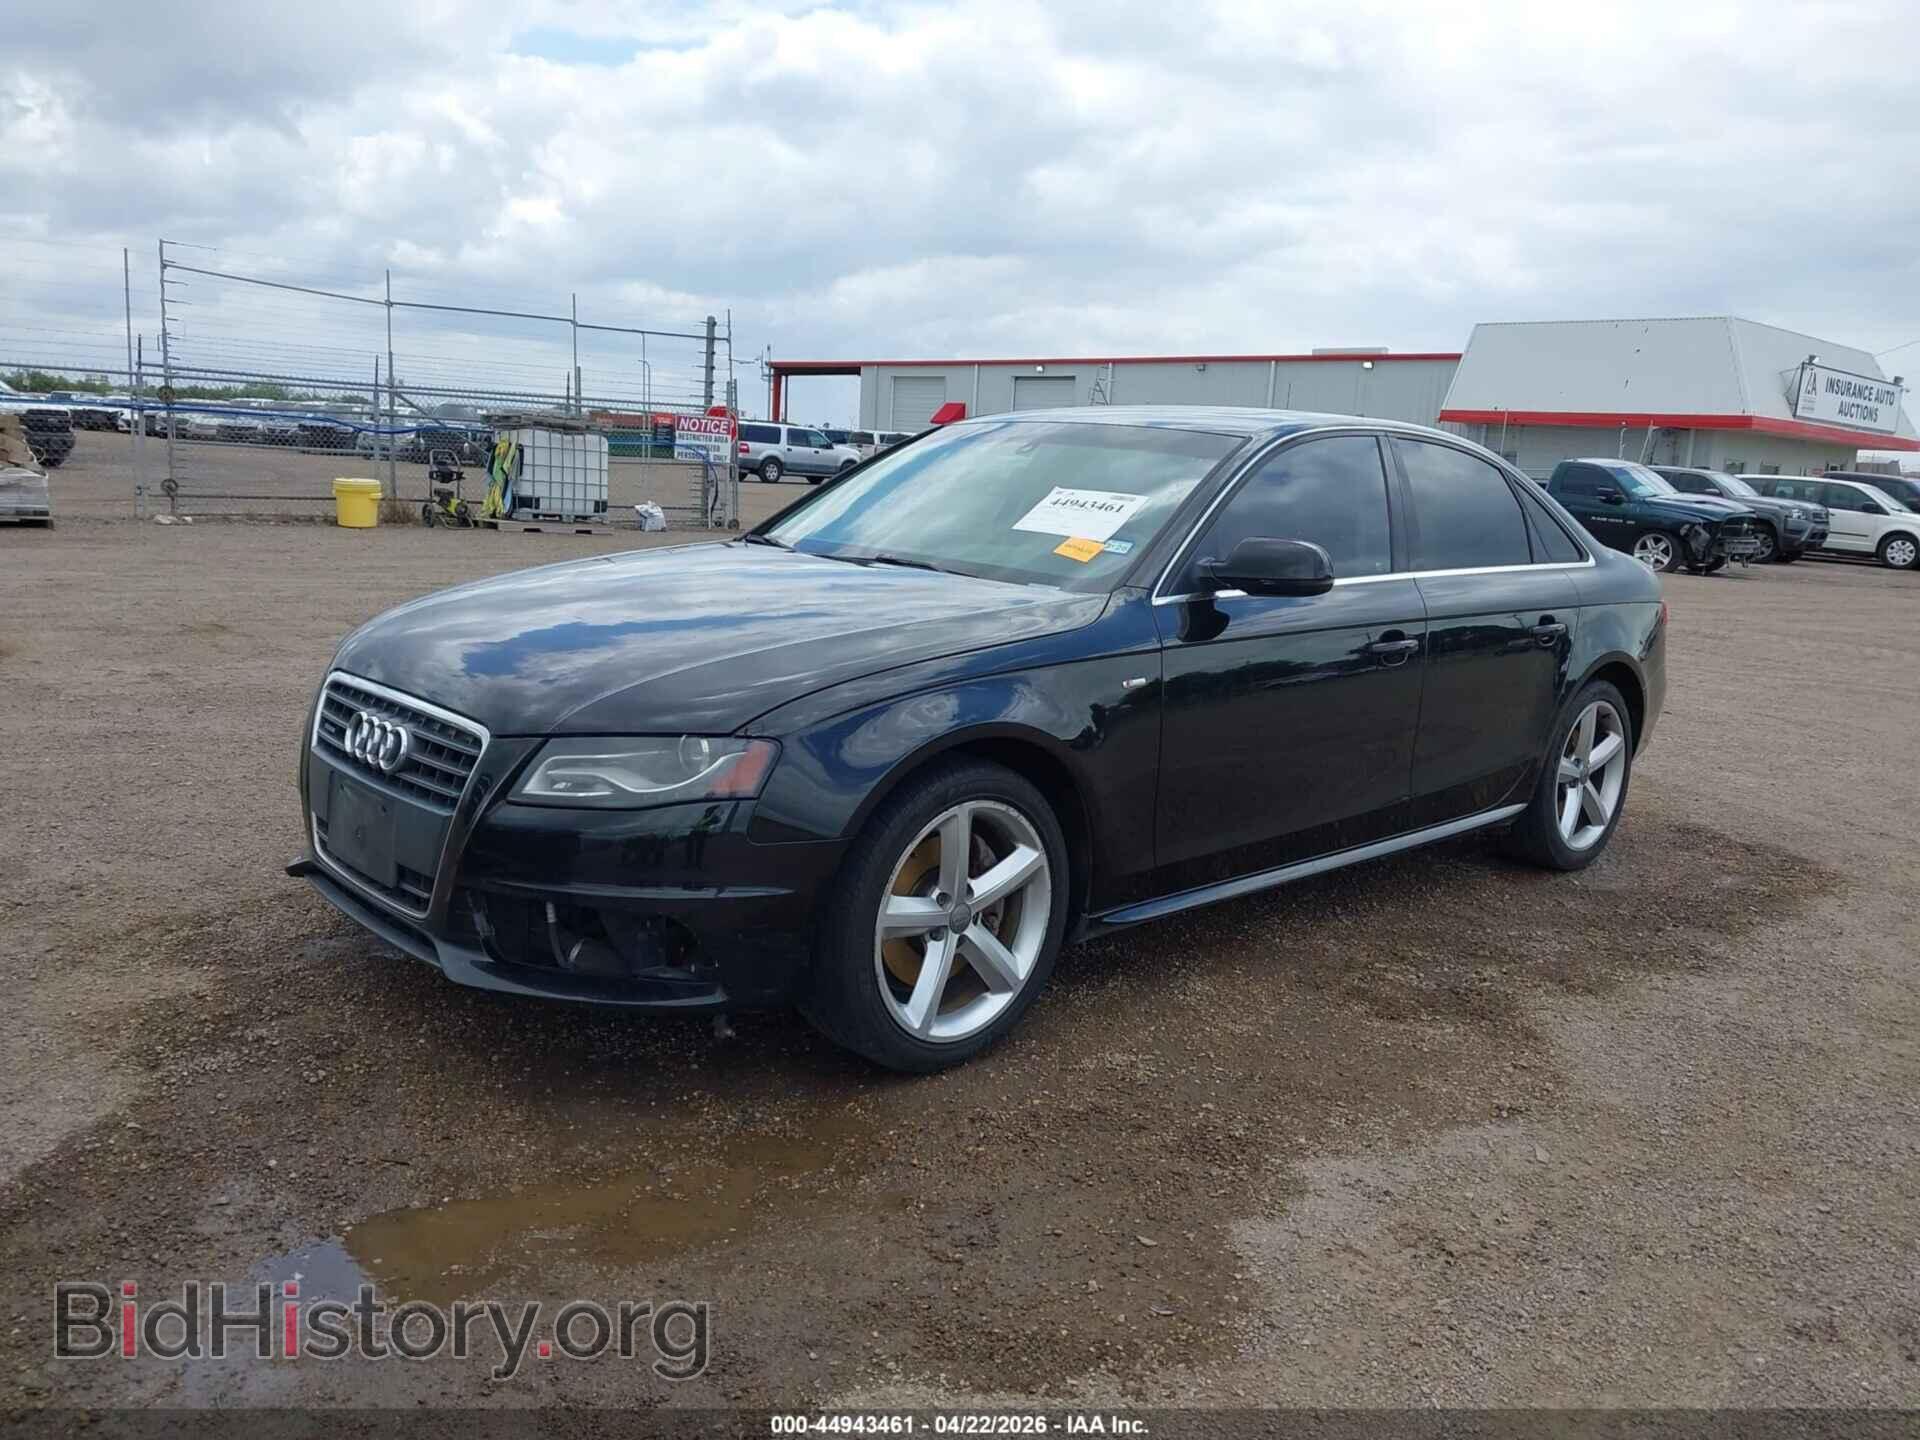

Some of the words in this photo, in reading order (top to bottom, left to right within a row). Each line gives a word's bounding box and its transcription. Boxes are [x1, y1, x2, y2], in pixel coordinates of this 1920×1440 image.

[1825, 376, 1873, 402] INSURANCE
[1874, 389, 1896, 406] AUTO
[1838, 400, 1879, 423] AUCTIONS
[679, 416, 728, 434] NOTICE
